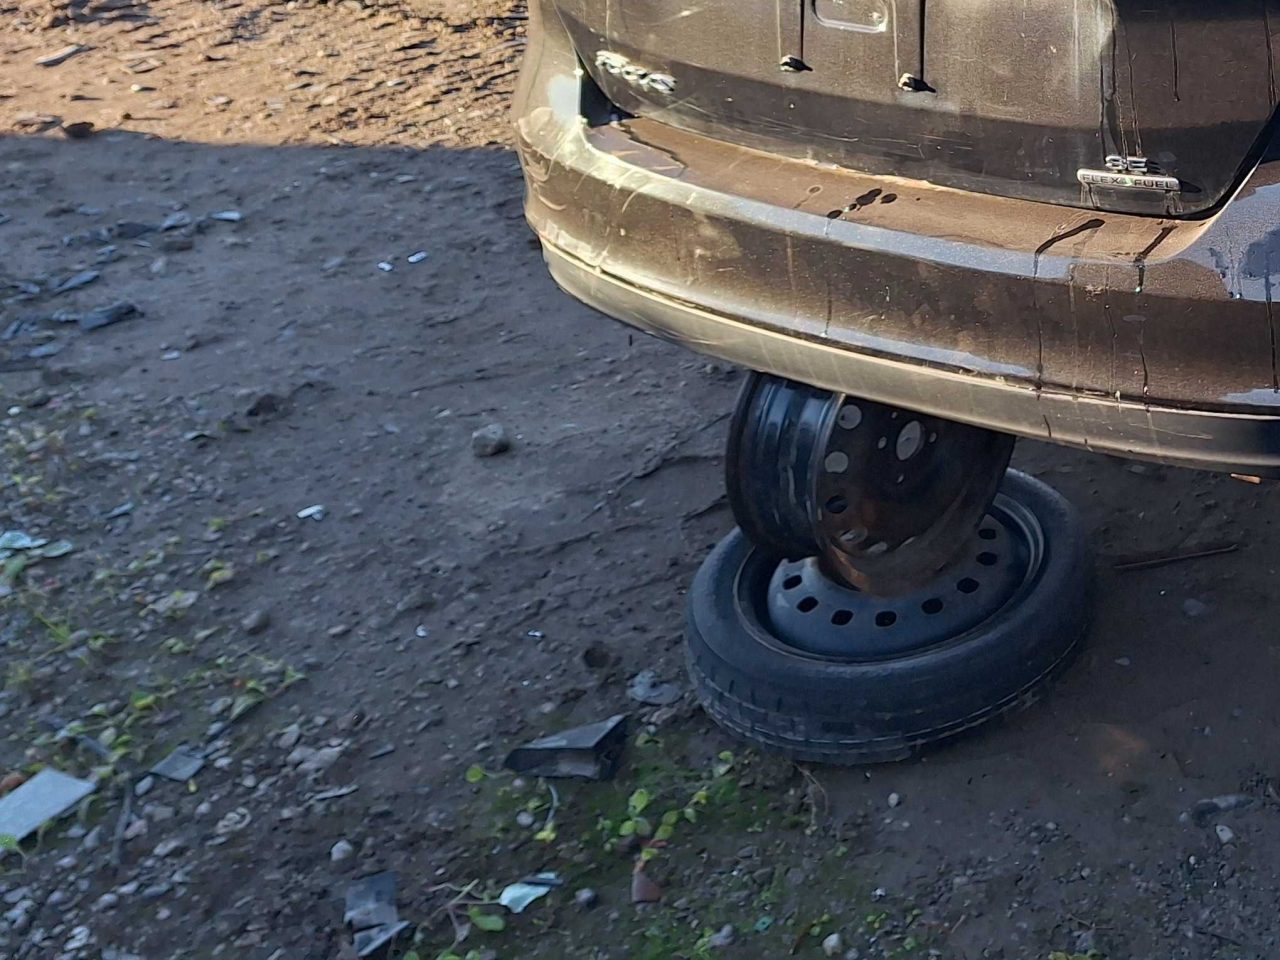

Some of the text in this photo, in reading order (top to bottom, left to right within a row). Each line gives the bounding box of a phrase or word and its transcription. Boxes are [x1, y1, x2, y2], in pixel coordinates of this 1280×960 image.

[1105, 155, 1147, 172] SE
[1082, 174, 1174, 189] FLEX FUEL
